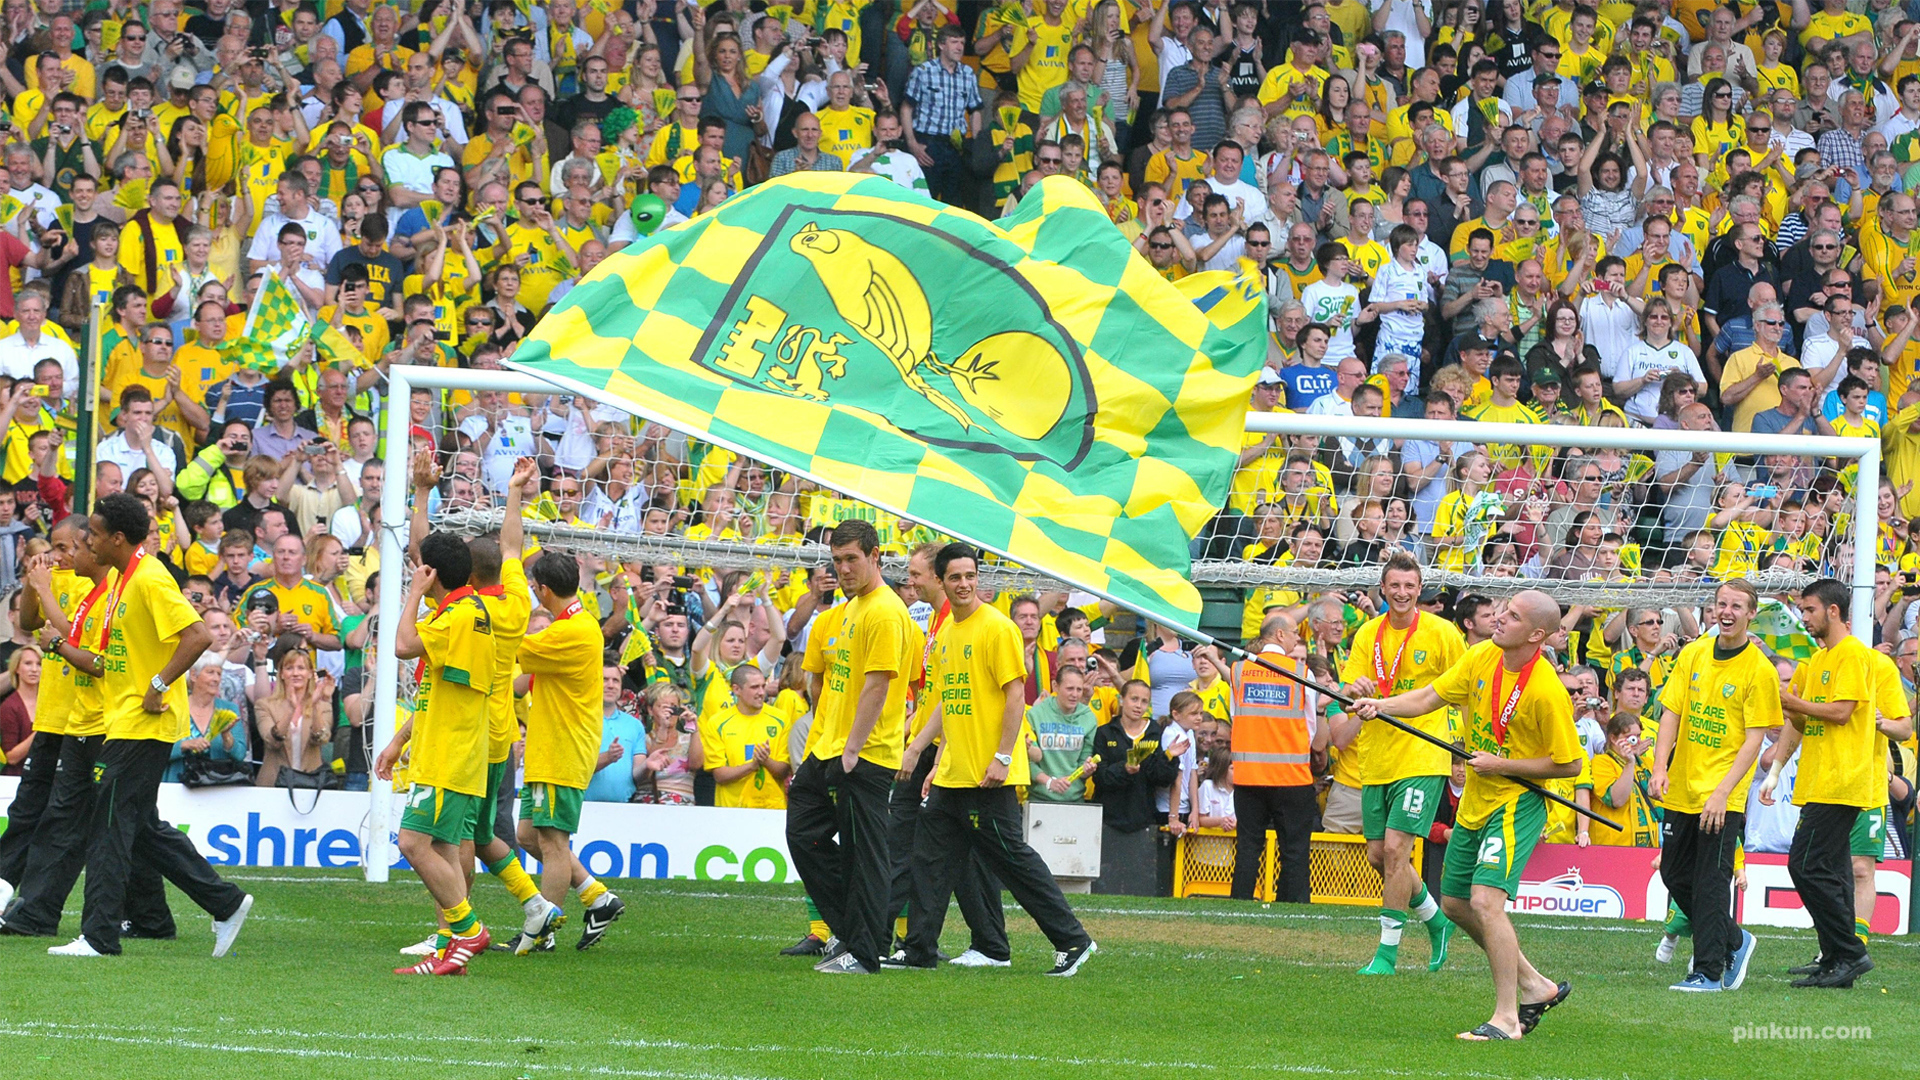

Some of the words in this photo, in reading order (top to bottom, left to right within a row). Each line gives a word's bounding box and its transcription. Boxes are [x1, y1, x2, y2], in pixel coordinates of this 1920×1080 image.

[1037, 60, 1065, 68] AVIVA
[1506, 57, 1532, 67] AVIVA
[1232, 77, 1259, 85] AVIVA
[831, 143, 862, 152] AVIVA
[833, 503, 876, 524] Going
[1241, 669, 1264, 678] SAFETY
[1500, 684, 1521, 727] npower
[1703, 705, 1726, 720] ARE
[1688, 714, 1727, 735] PREMIER
[1804, 724, 1825, 737] GUE
[1402, 787, 1425, 814] 13
[1868, 815, 1882, 839] 7
[1511, 895, 1607, 914] npower
